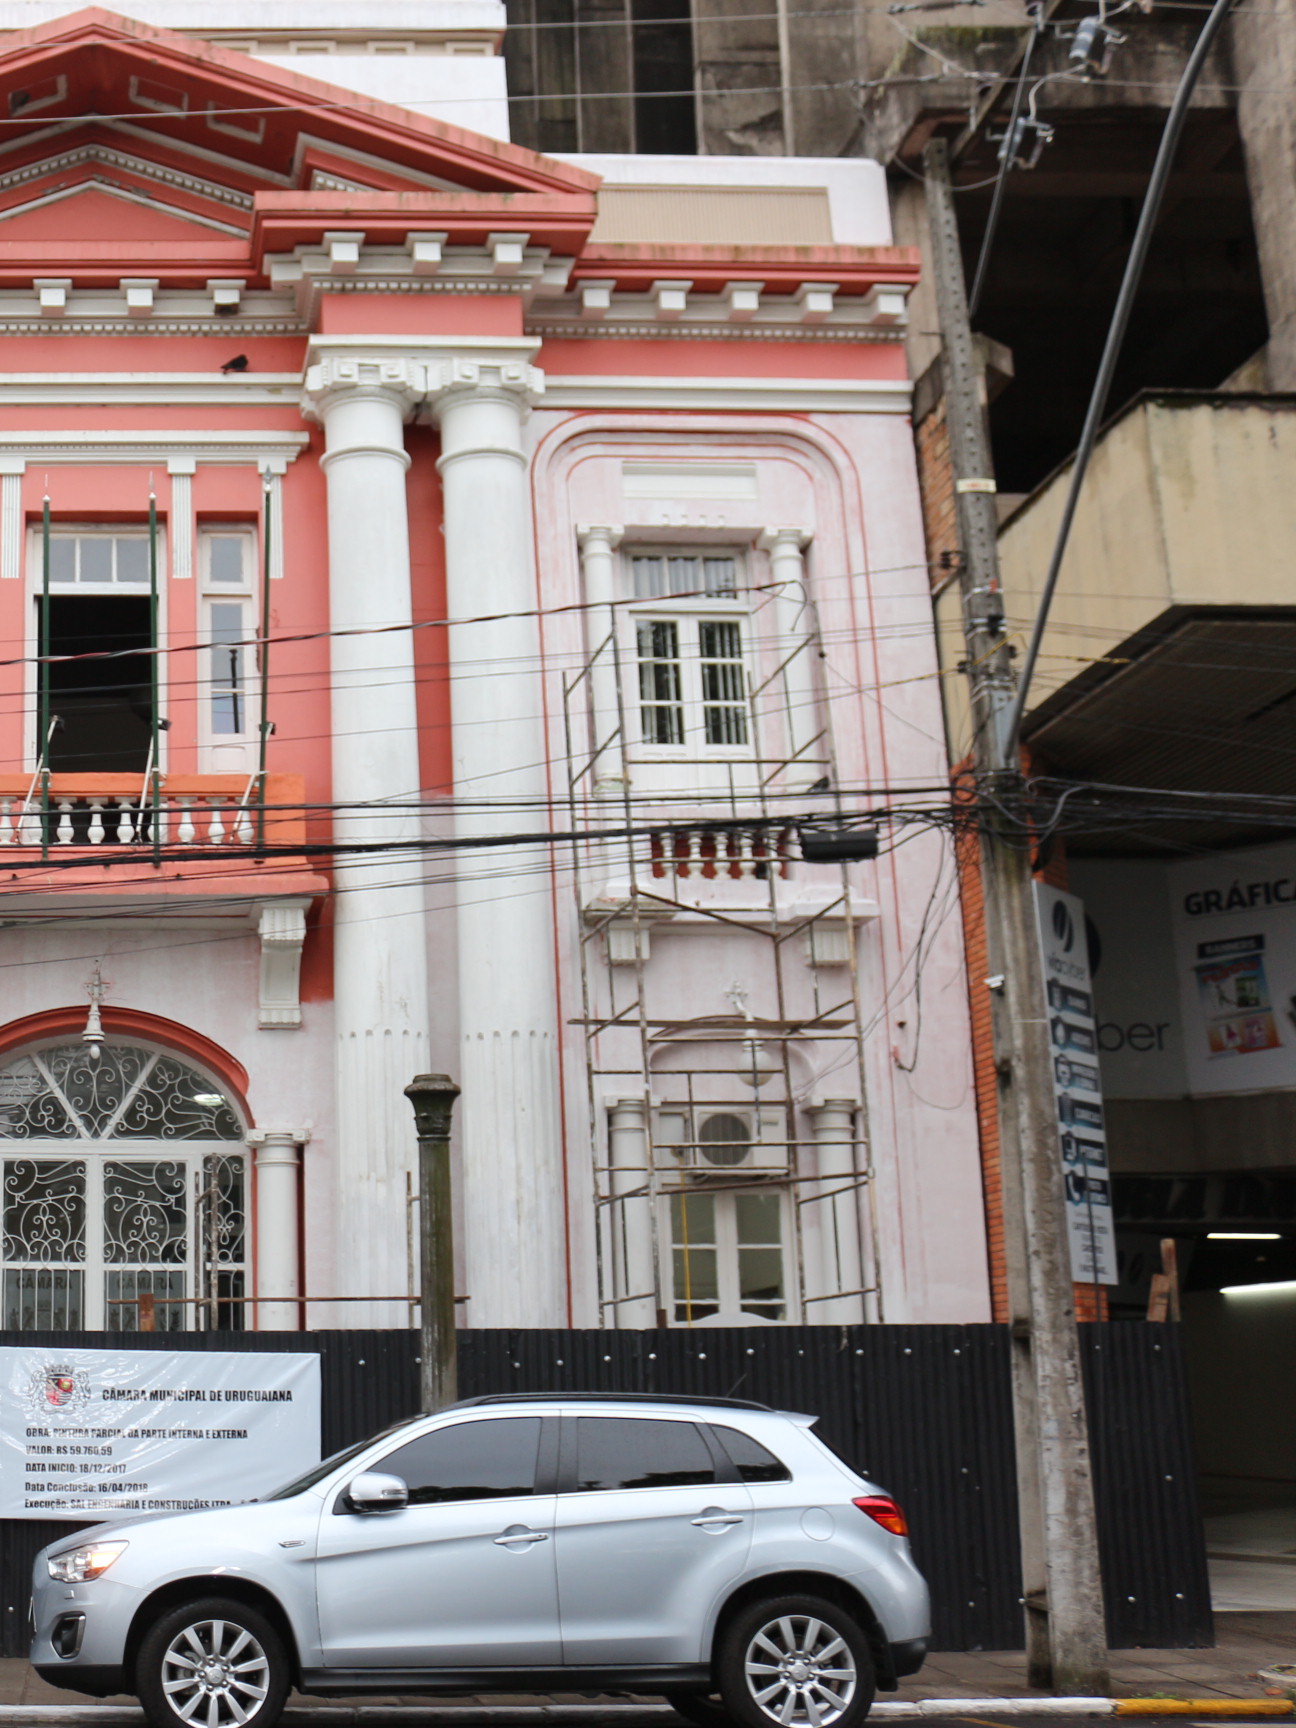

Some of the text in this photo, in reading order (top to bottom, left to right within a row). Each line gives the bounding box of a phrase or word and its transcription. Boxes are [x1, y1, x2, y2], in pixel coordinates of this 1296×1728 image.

[1185, 879, 1296, 915] GRÁFIC
[102, 1387, 293, 1402] CÂMARA MUNICIPAL DE URUGUAIANA
[91, 1428, 125, 1439] PARCIAL
[127, 1429, 140, 1439] DA
[141, 1429, 167, 1439] PARTE
[168, 1429, 204, 1439] INTERNA
[205, 1429, 211, 1439] E
[212, 1429, 249, 1439] EXTERNA
[26, 1445, 55, 1455] VALOR:
[25, 1463, 46, 1473] DATA
[79, 1463, 127, 1474] 18/12/2017
[24, 1482, 149, 1493] Data Conclusão: 16/04/2018
[24, 1498, 69, 1510] Execução:
[141, 1500, 147, 1510] E
